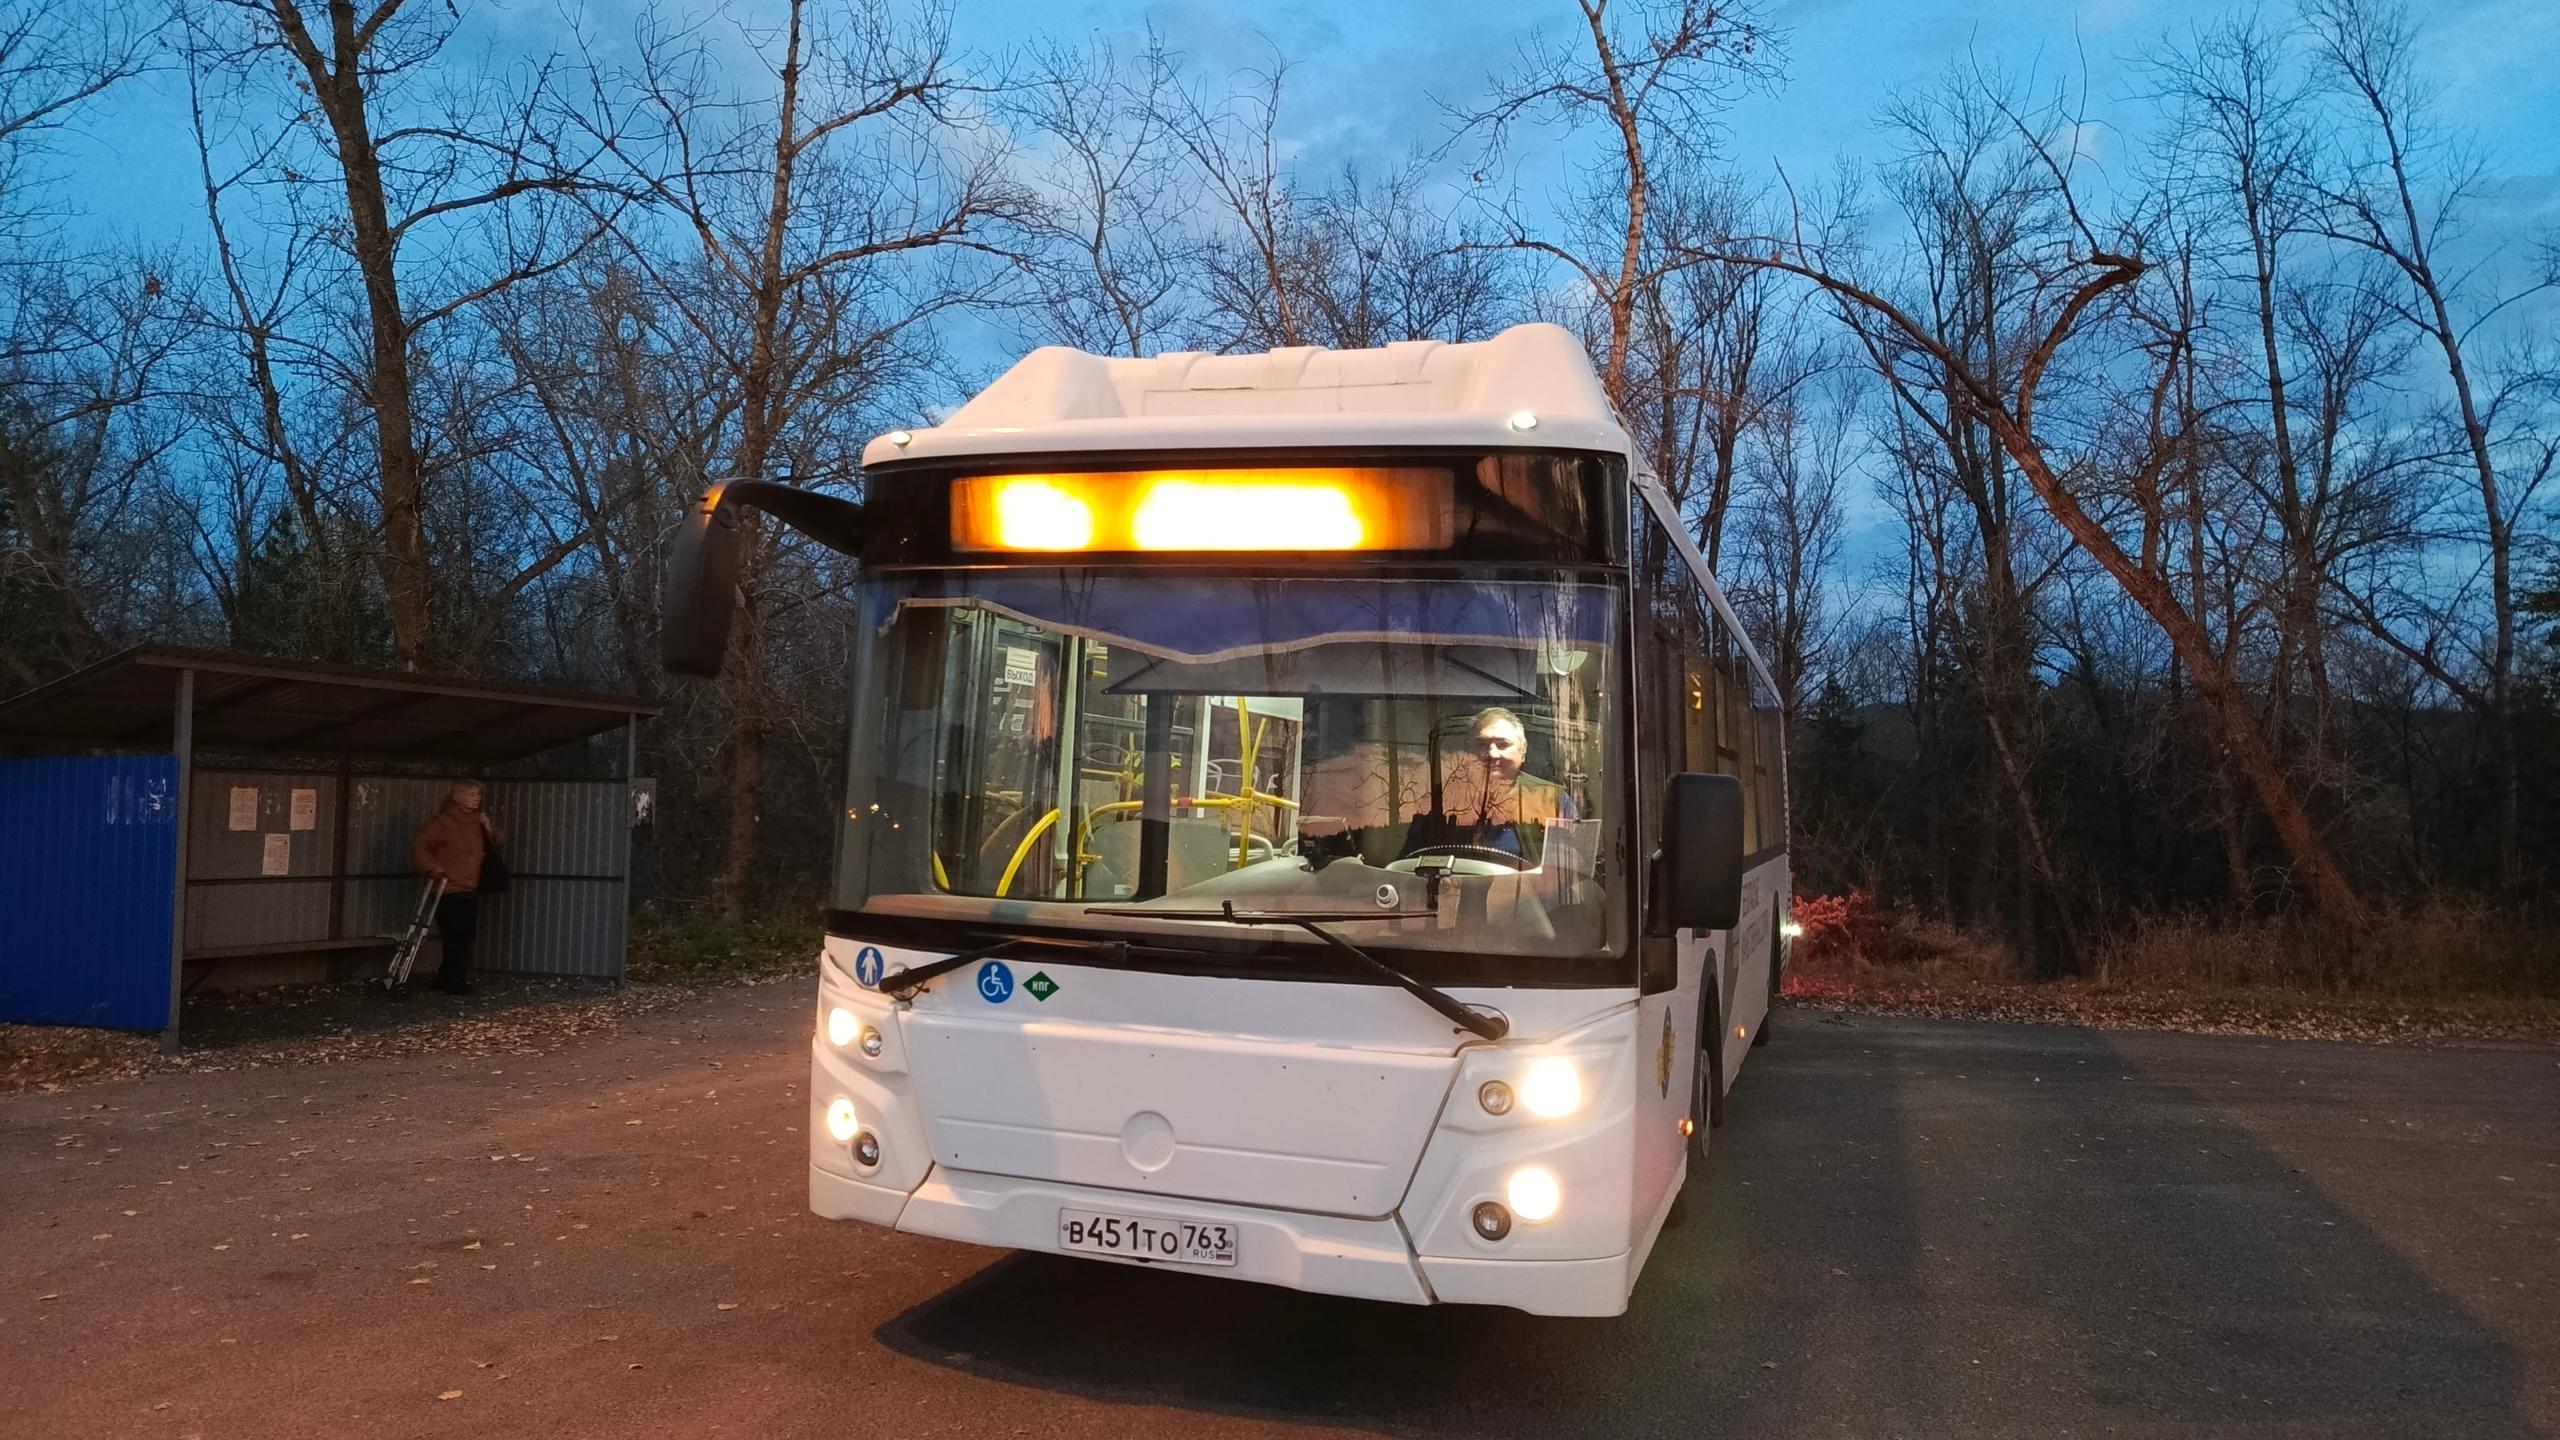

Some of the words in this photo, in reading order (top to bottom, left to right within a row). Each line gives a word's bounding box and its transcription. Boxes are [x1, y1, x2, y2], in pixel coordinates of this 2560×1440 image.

[1007, 669, 1033, 683] ВЫХОД
[1032, 980, 1050, 992] КПГ
[1069, 1217, 1178, 1254] В451ТО
[1183, 1225, 1227, 1250] 763
[1192, 1249, 1215, 1260] RUS
